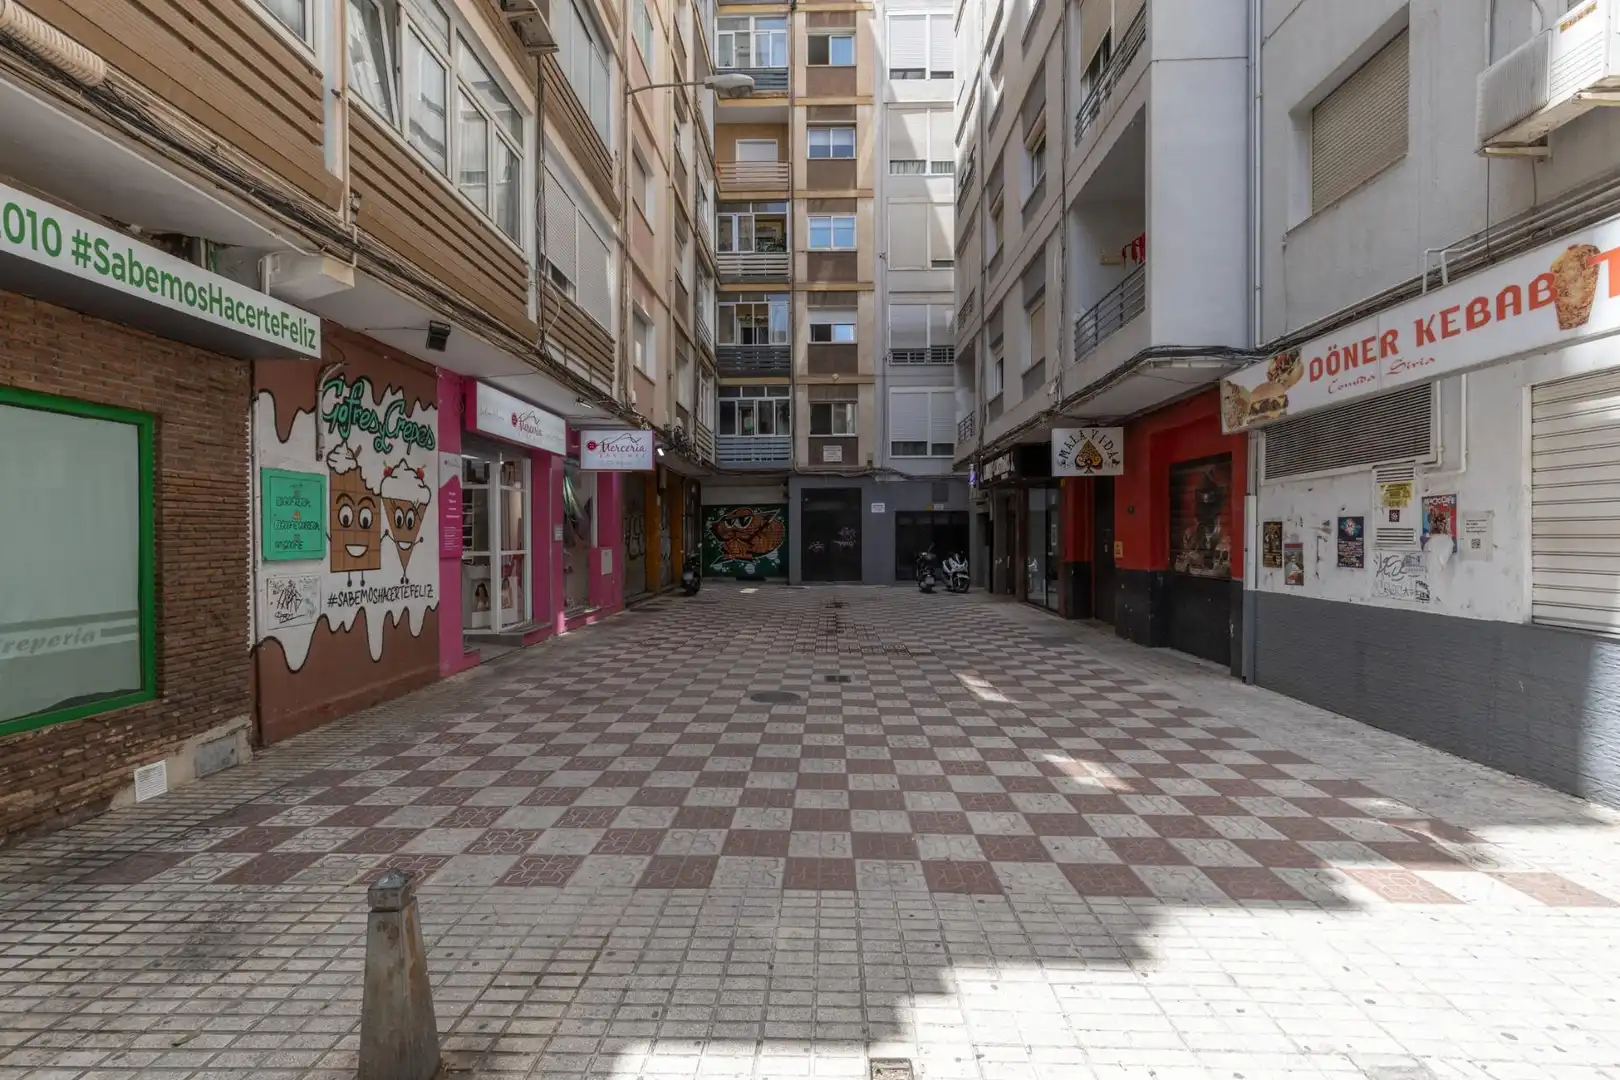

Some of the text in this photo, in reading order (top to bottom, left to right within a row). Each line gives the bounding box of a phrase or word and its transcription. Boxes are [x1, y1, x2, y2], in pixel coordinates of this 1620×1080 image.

[71, 229, 317, 350] #SabemosHacerteFeliz
[1308, 271, 1559, 383] DÖNER KEBAB
[321, 376, 379, 440] Gofres
[384, 398, 435, 456] Crepes
